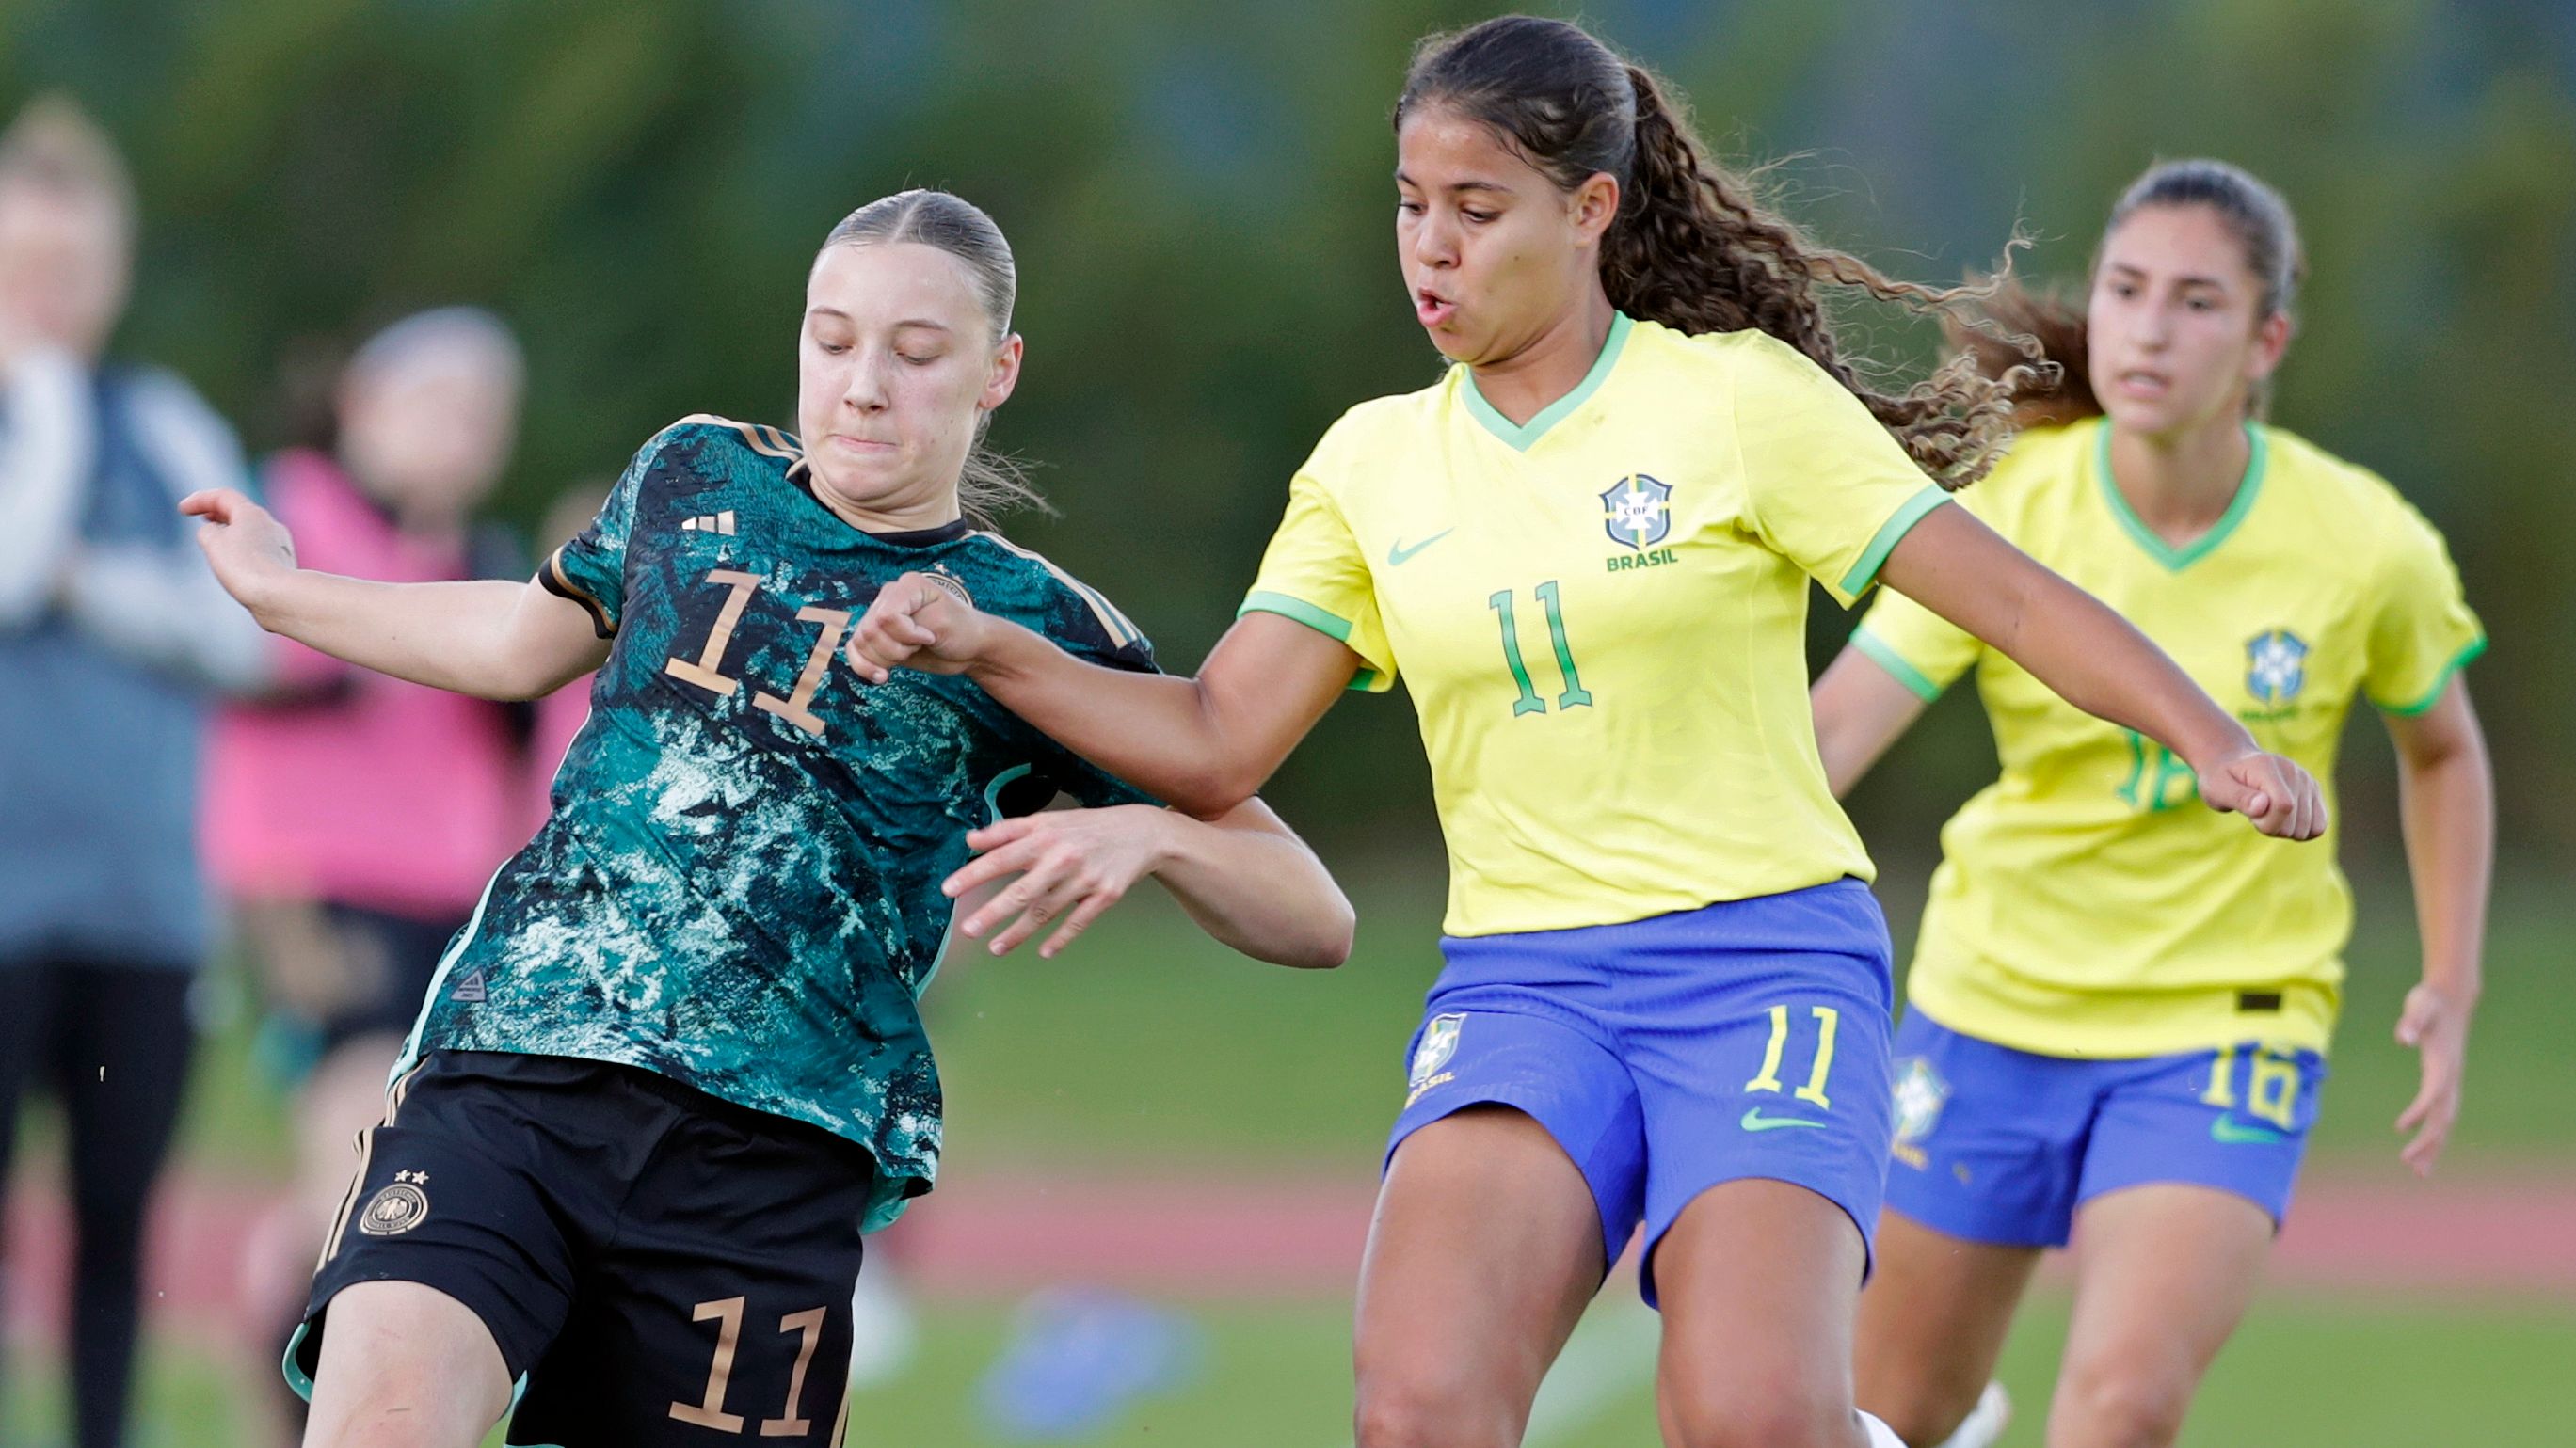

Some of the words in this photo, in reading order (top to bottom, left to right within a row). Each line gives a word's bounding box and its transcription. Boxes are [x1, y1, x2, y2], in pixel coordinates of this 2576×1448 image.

[1607, 549, 1678, 572] BRASIL
[665, 569, 849, 735] 11
[1489, 581, 1592, 717] 11
[1744, 1004, 1838, 1111] 11
[2200, 1046, 2297, 1132] 16
[669, 1296, 827, 1437] 11
